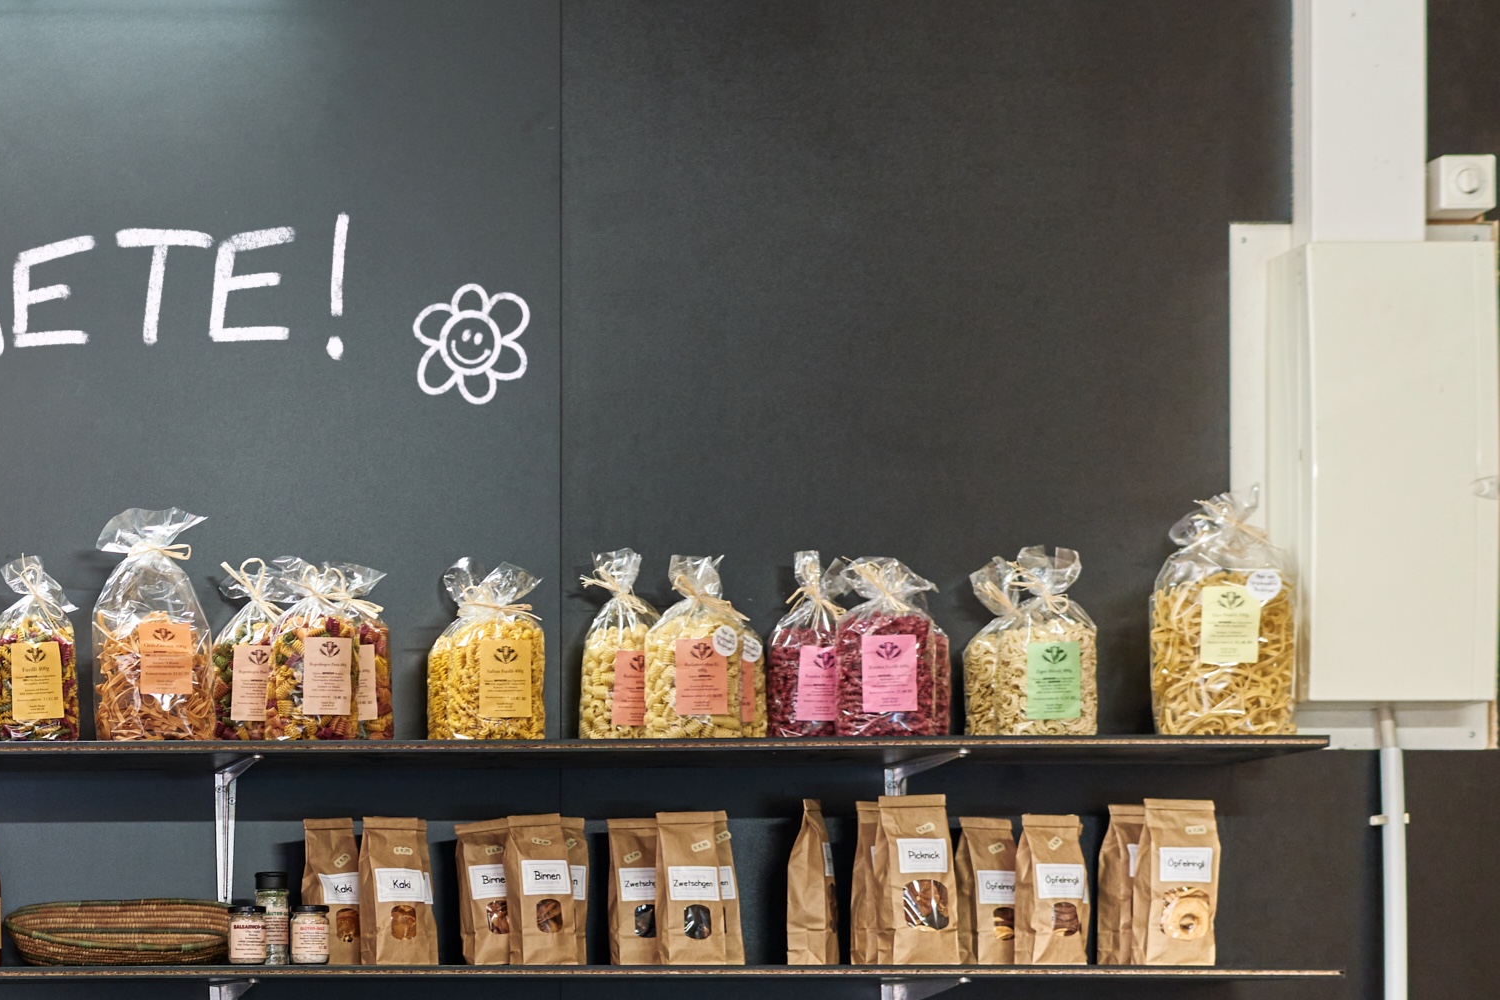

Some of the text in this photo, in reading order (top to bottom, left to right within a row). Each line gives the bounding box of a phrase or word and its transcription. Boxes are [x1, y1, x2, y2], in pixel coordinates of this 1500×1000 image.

[908, 851, 940, 860] Picknick
[481, 875, 506, 885] Birne
[534, 870, 561, 881] Birnen
[333, 884, 353, 894] Kaki
[392, 879, 412, 889] Kaki
[673, 880, 713, 889] Zwetschgen
